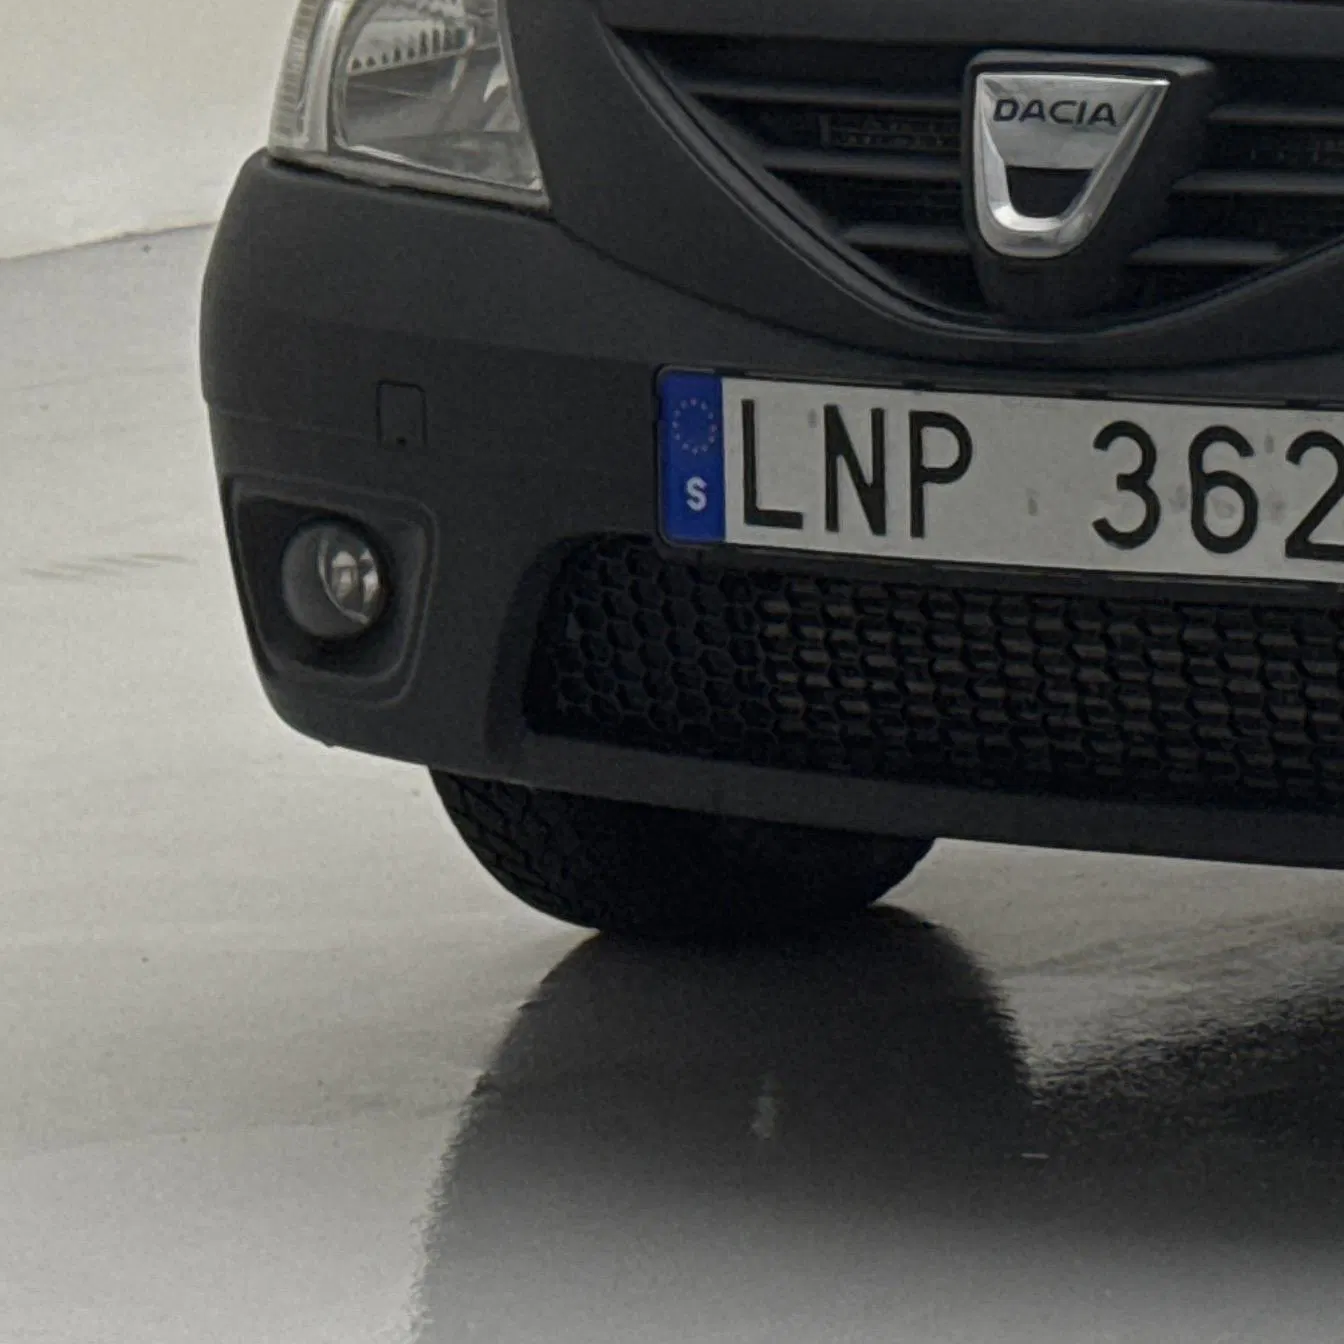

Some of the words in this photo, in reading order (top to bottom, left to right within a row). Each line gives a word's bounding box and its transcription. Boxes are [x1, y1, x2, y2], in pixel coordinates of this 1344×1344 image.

[993, 99, 1117, 127] DACIA
[741, 399, 973, 539] LNP
[686, 476, 708, 512] S
